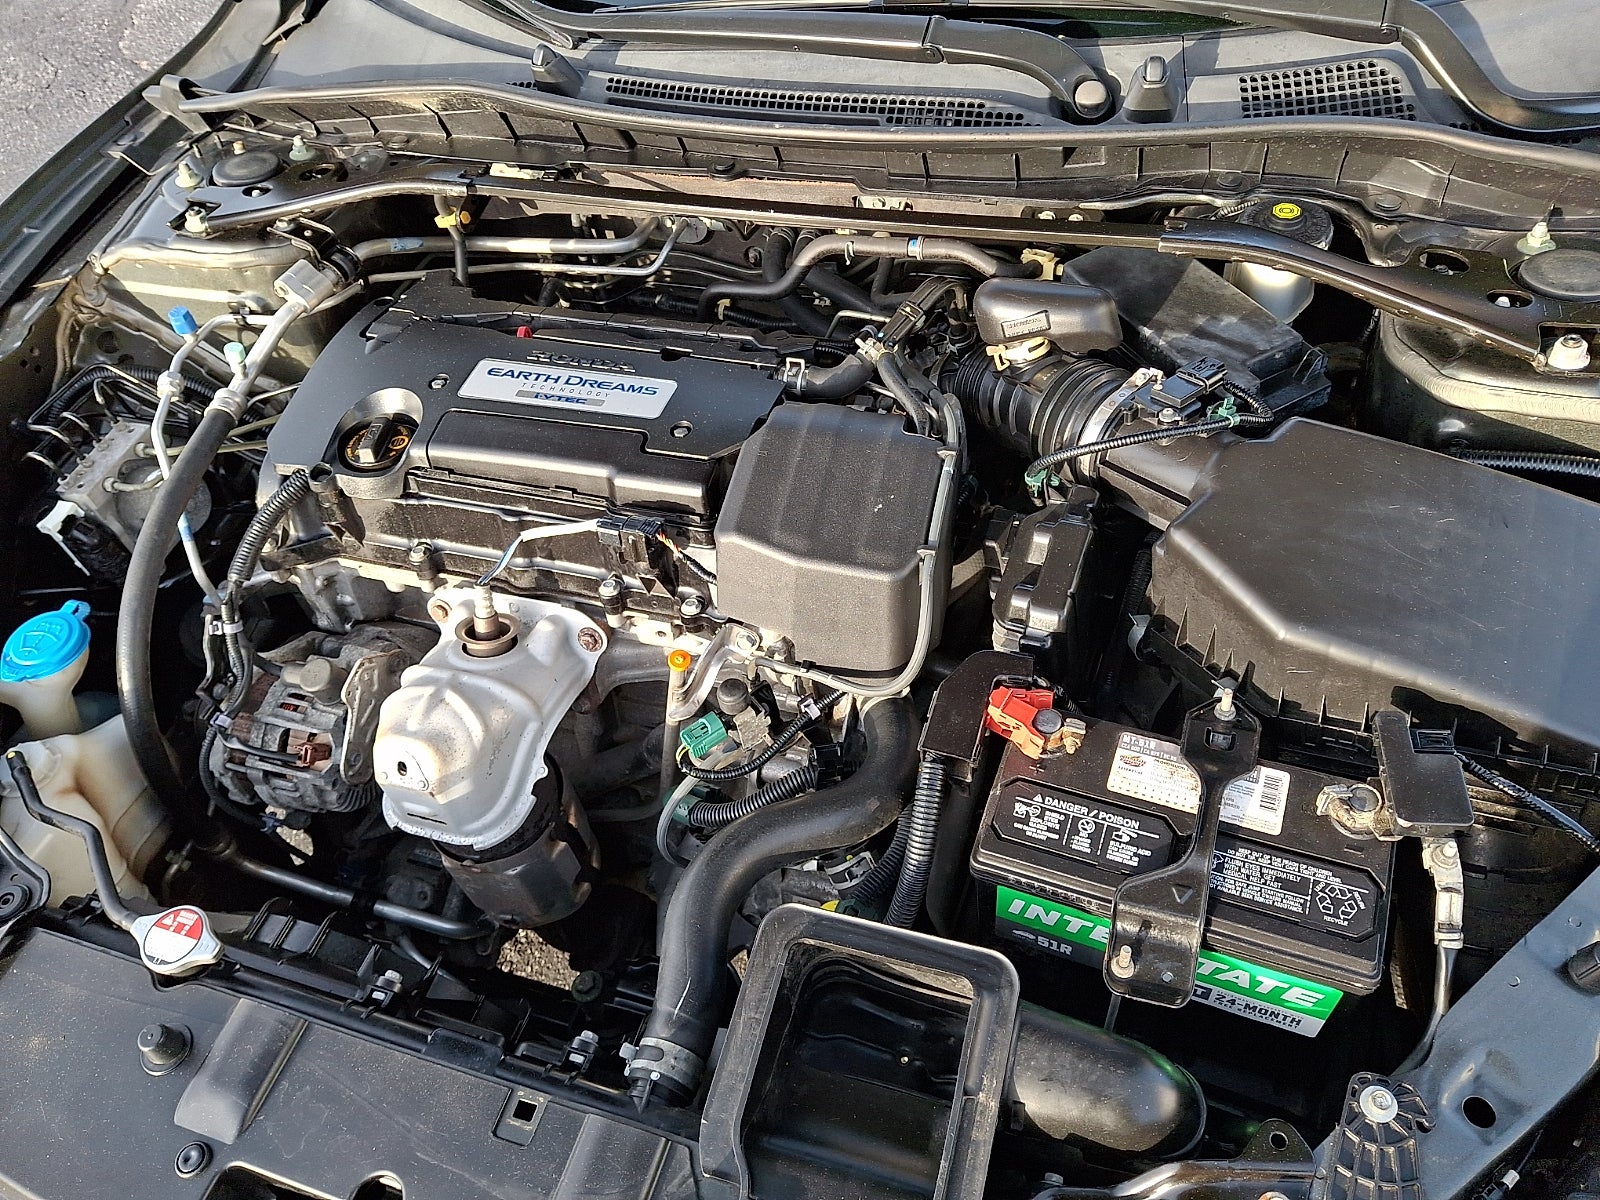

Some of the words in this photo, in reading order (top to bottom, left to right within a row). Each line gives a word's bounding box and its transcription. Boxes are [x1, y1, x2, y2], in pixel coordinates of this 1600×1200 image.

[526, 350, 636, 373] HONDA
[487, 367, 562, 385] EARTH
[564, 375, 659, 396] DREAMS
[521, 382, 610, 398] TECHNOLOGY
[1044, 796, 1089, 815] DANGER
[1099, 811, 1140, 830] POISON
[1137, 848, 1152, 857] ACID
[1235, 850, 1248, 858] NOT
[1299, 868, 1315, 877] TIGHT
[1238, 847, 1251, 855] KEEP
[1271, 856, 1282, 864] THE
[1307, 865, 1333, 877] CHILDREN
[1223, 862, 1240, 871] WITH
[1263, 873, 1276, 881] GET
[1223, 868, 1248, 880] MEDICAL
[1249, 876, 1266, 885] HELP
[1266, 880, 1283, 889] FAST
[1225, 856, 1244, 866] FLUSH
[1244, 862, 1261, 871] EYES
[1261, 867, 1302, 882] IMMEDIATELY
[1210, 878, 1236, 889] TRUCTIONS
[1235, 880, 1248, 888] SAFE
[1261, 888, 1285, 898] STARTING
[1285, 894, 1305, 904] FOLLOW
[1314, 881, 1326, 893] LEAD
[1352, 891, 1366, 910] RETURN
[1323, 915, 1349, 927] RECYCLE
[1037, 936, 1073, 955] 51R
[1213, 993, 1303, 1026] 24-MONTH
[1236, 1006, 1298, 1030] REPLACEMENT
